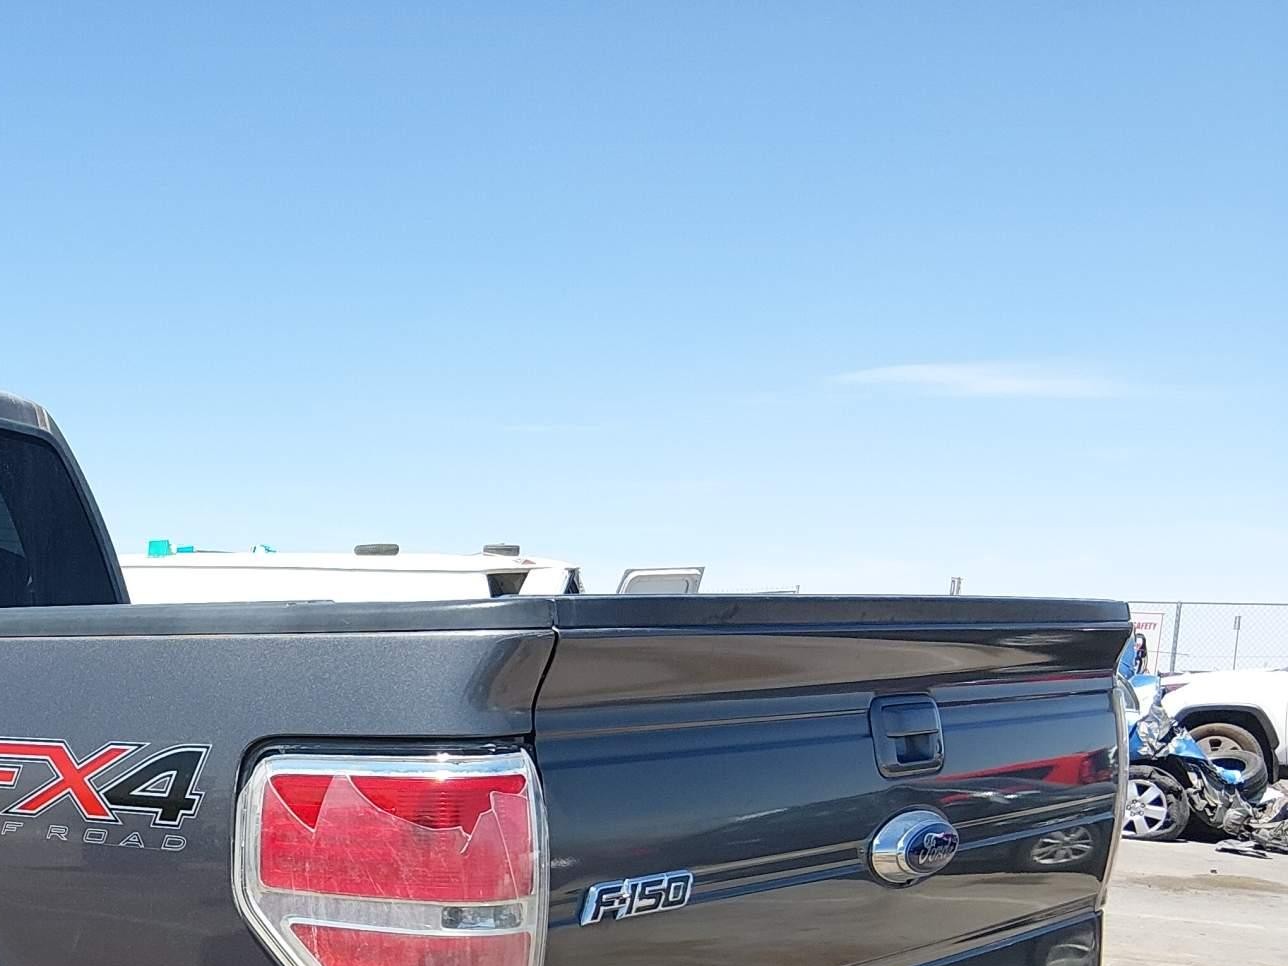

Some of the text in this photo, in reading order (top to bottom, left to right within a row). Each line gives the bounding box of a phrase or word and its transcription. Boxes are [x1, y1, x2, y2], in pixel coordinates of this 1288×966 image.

[46, 825, 187, 851] ROAD
[918, 831, 957, 865] Ford
[581, 870, 693, 926] F-150
